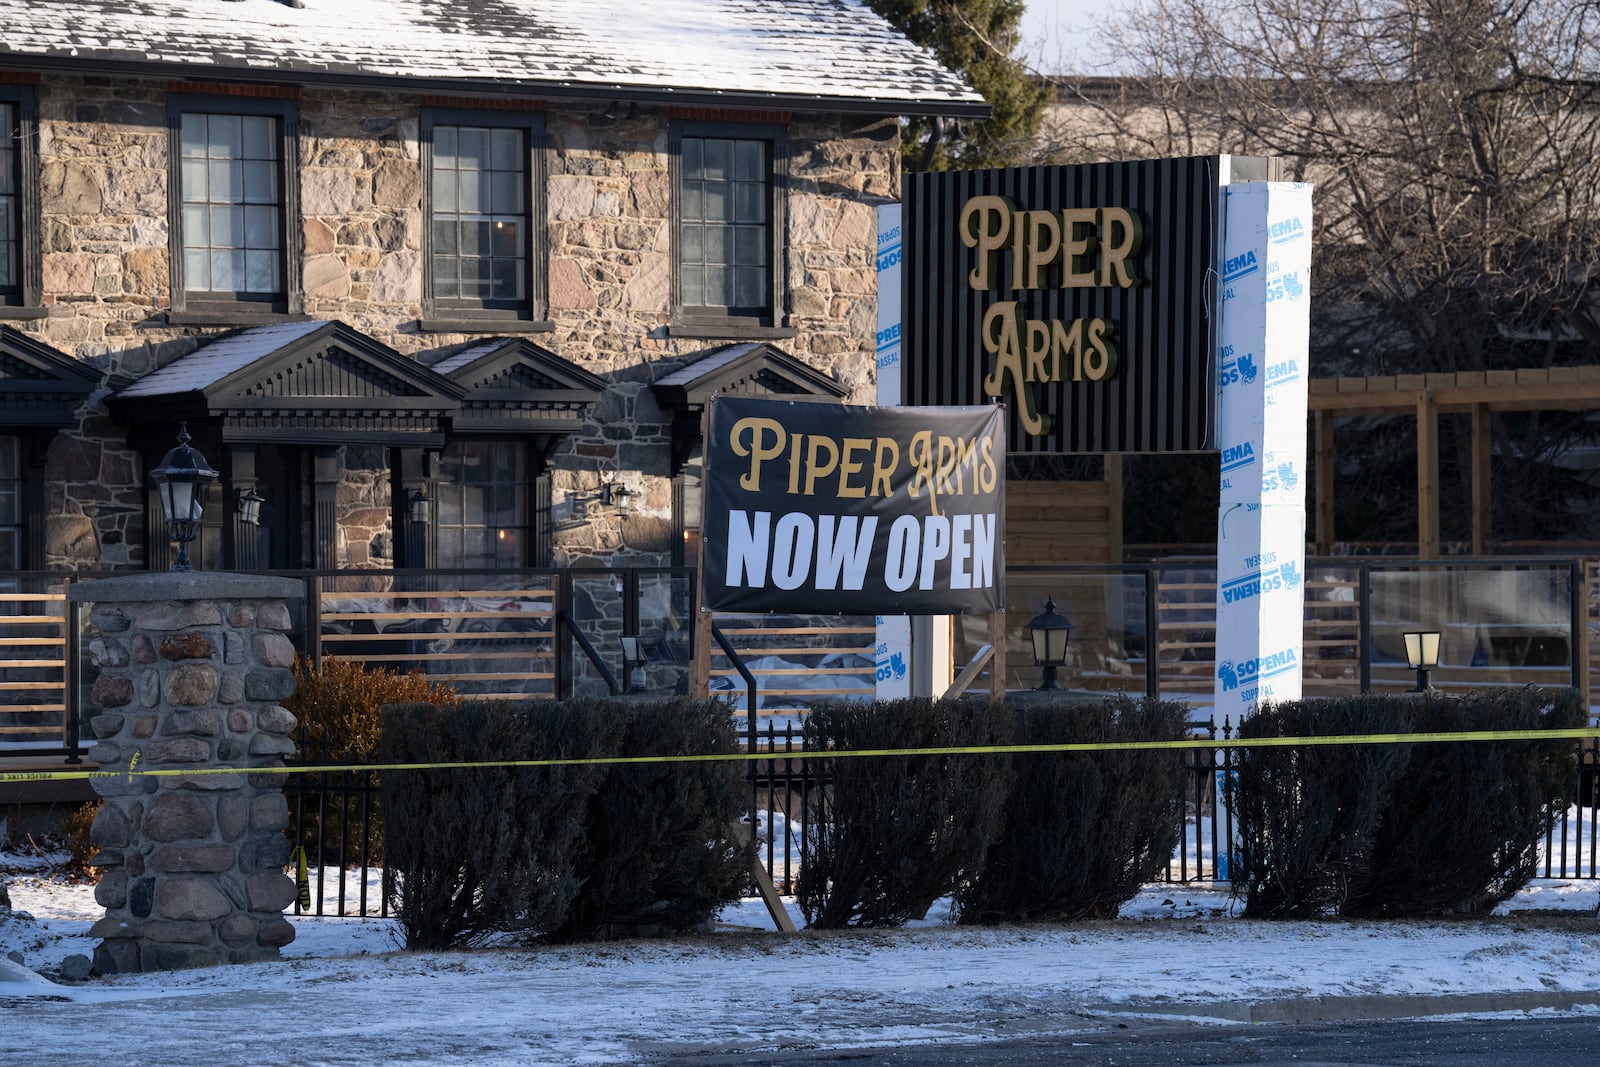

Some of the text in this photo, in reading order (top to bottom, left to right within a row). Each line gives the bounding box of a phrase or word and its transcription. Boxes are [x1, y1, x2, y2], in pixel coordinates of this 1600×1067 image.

[959, 195, 1142, 290] PIPER
[982, 301, 1115, 435] ARMS
[730, 417, 997, 517] PIPER ARMS
[725, 510, 997, 593] NOW OPEN
